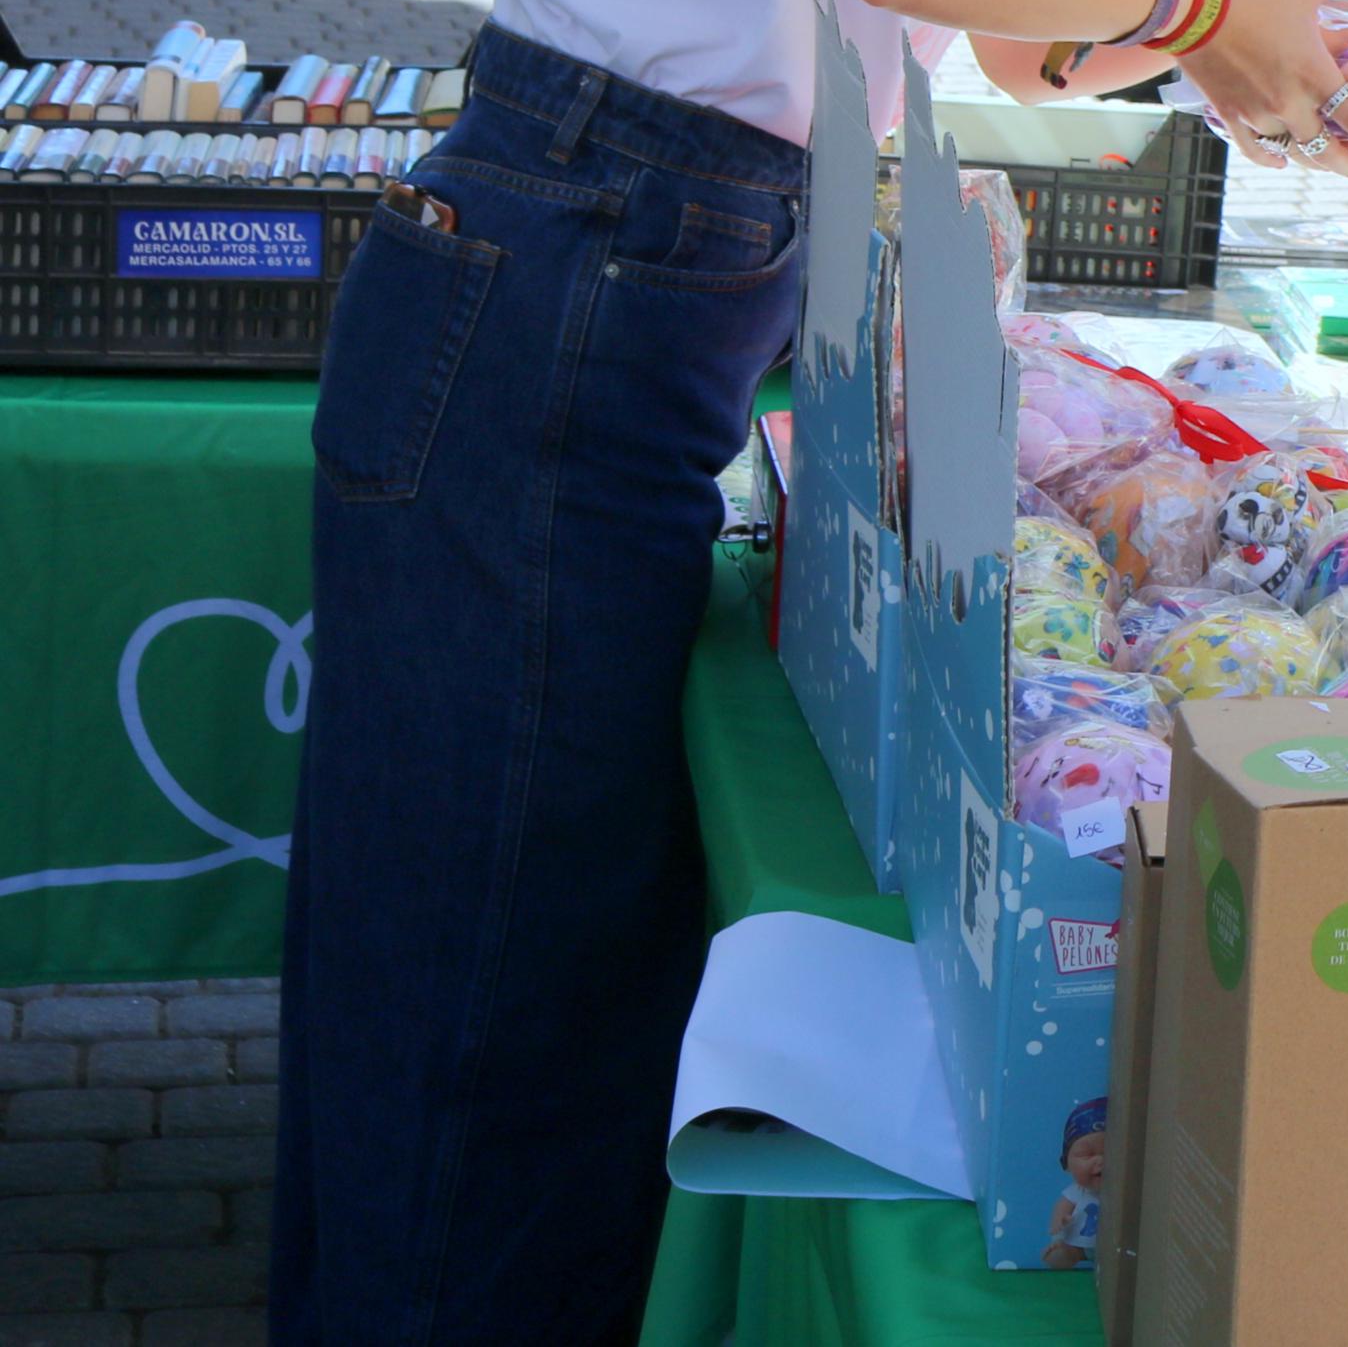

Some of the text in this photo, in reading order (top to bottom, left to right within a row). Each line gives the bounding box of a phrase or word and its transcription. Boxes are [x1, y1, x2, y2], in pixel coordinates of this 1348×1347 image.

[133, 244, 212, 255] MERCAOLID
[222, 244, 261, 255] PTOS.
[263, 244, 278, 255] 25
[282, 244, 290, 255] Y
[292, 244, 307, 255] 27
[129, 256, 256, 267] MERCASALAMANCA
[286, 257, 294, 268] Y
[1059, 925, 1095, 946] BABY
[1329, 955, 1345, 966] DE
